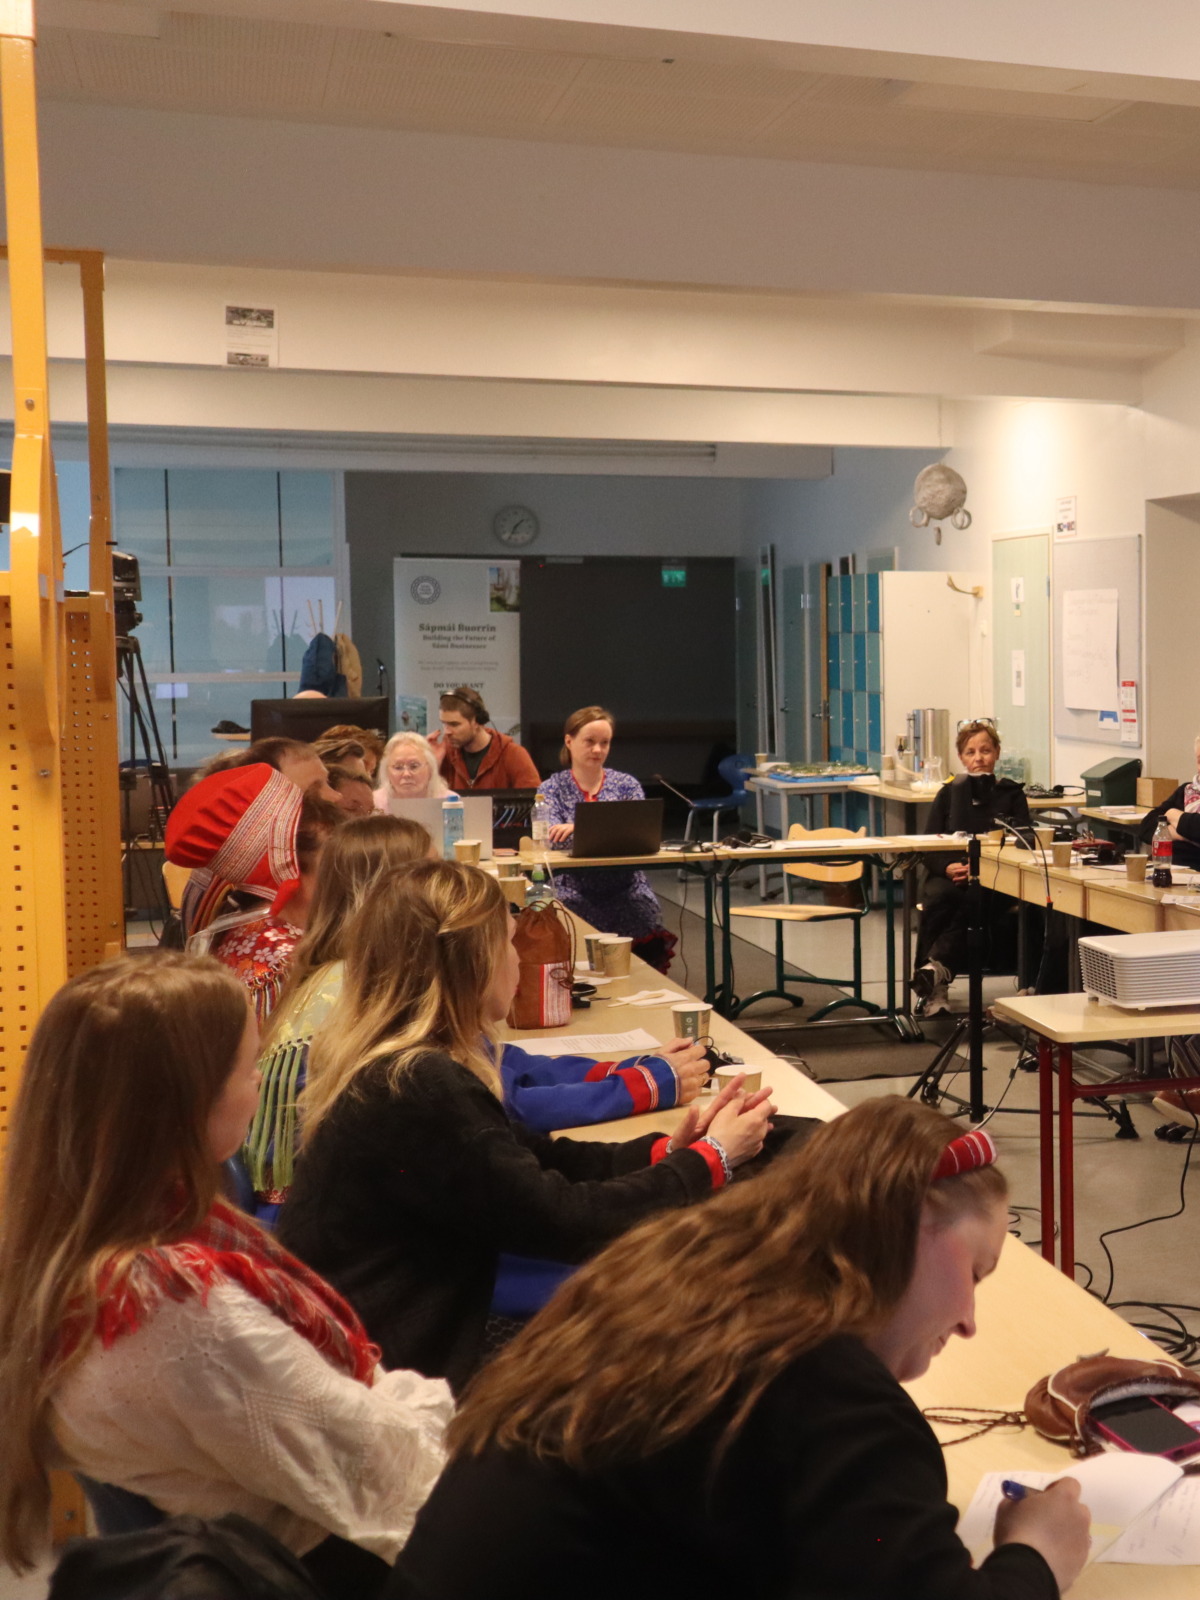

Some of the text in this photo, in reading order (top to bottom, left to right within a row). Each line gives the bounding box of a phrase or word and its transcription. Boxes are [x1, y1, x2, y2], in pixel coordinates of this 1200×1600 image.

[418, 622, 496, 634] Sápmái Buorrin
[423, 634, 451, 642] Building
[433, 681, 444, 689] DO
